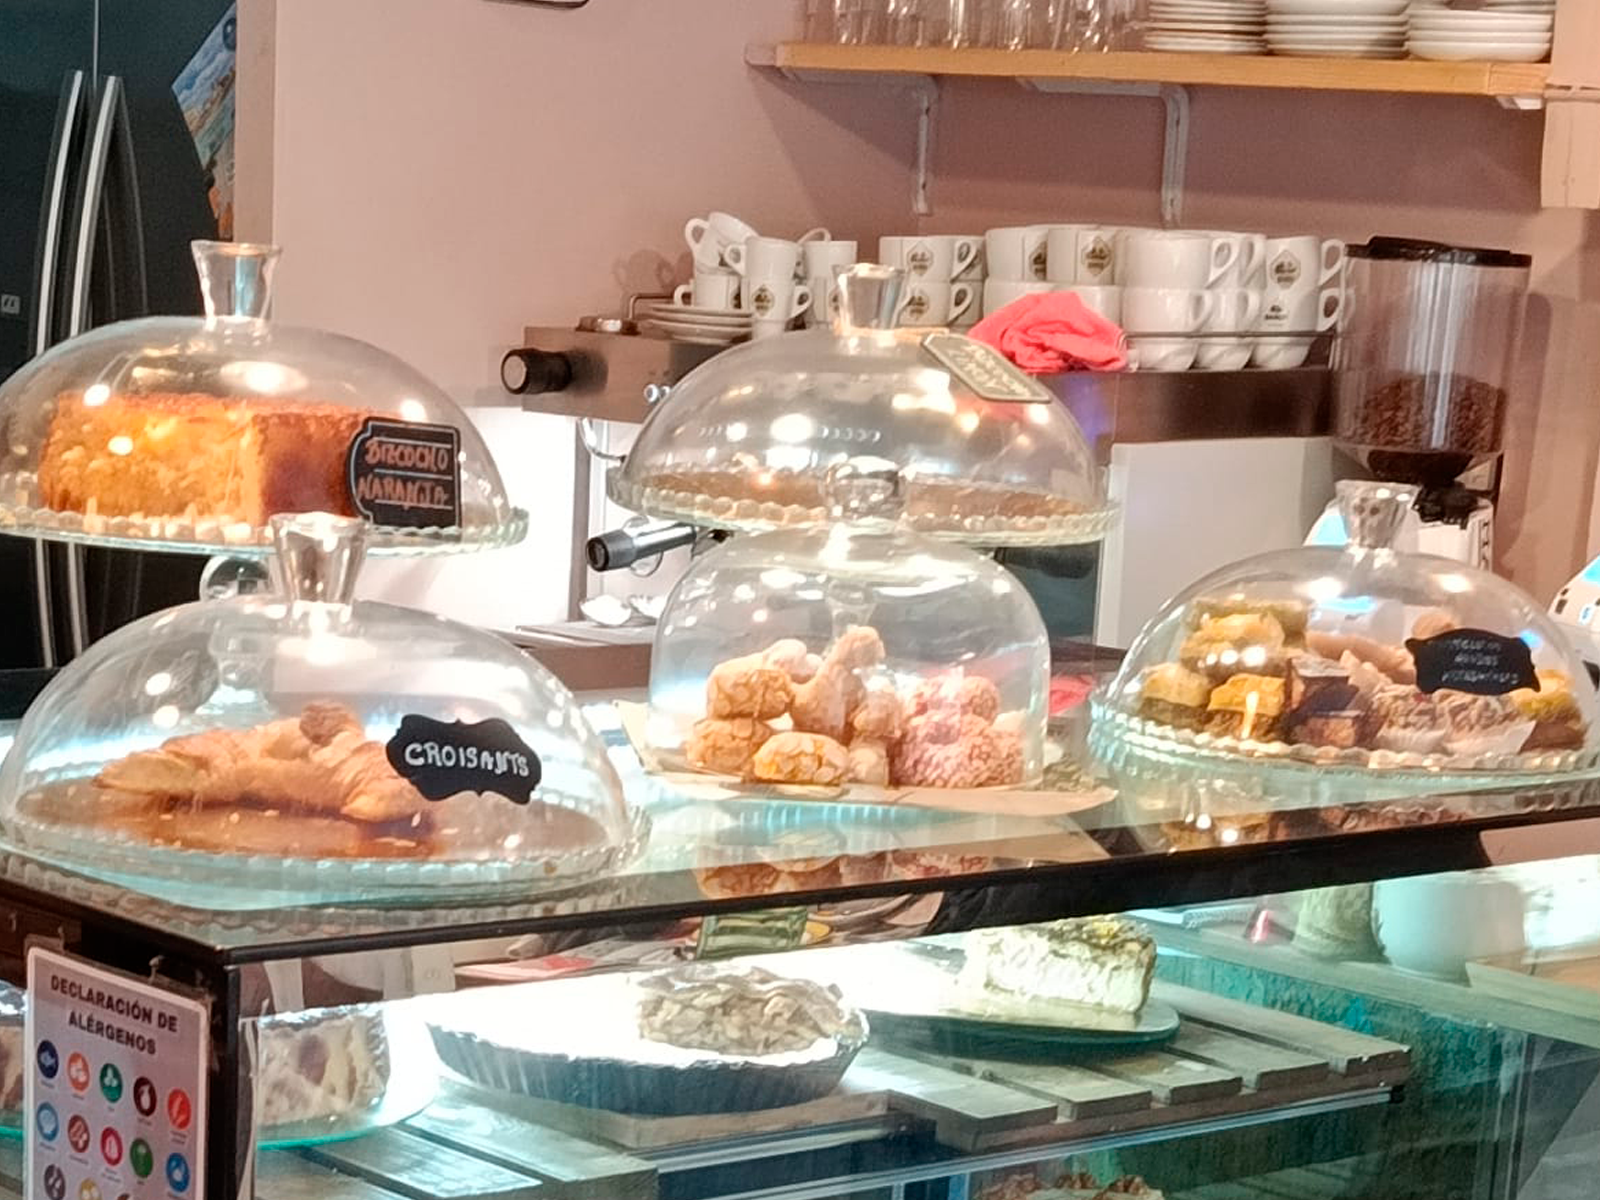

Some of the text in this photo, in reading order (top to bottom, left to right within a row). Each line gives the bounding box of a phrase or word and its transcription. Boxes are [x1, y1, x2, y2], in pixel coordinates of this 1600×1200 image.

[404, 742, 529, 777] CROISANTS
[51, 975, 178, 1032] DECLARACIÓN DE
[68, 1011, 156, 1055] ALÉRGENOS
